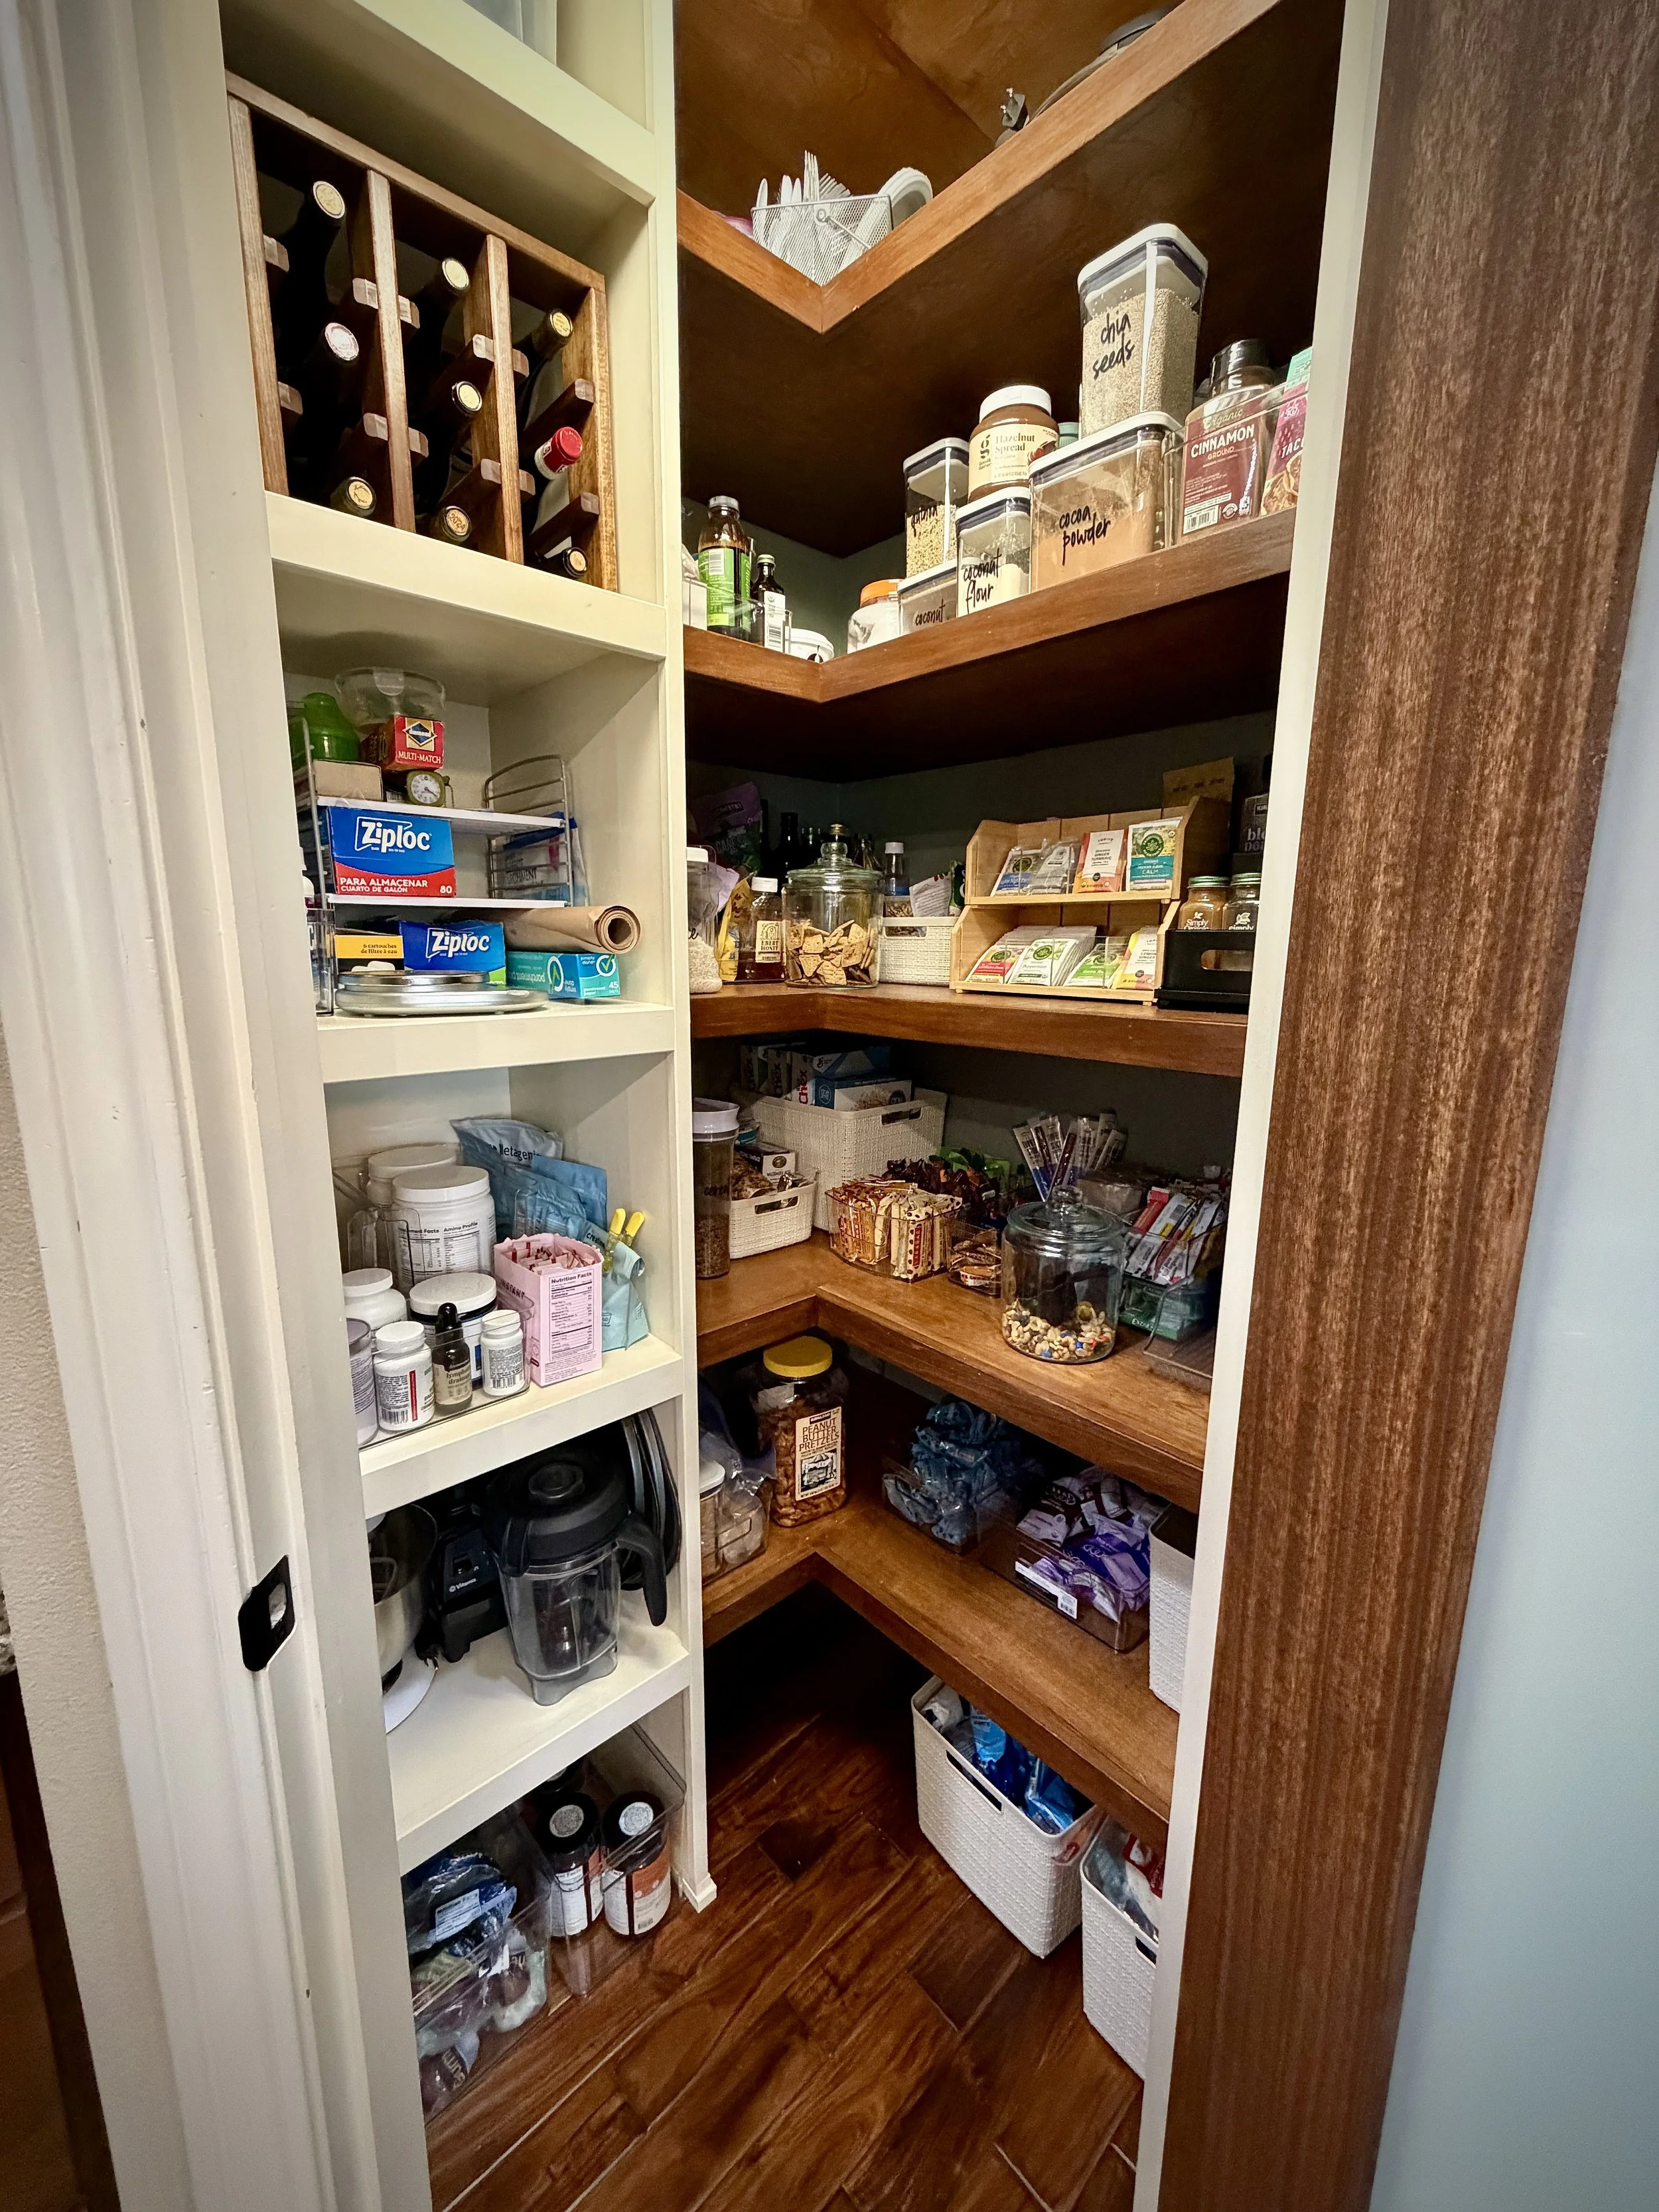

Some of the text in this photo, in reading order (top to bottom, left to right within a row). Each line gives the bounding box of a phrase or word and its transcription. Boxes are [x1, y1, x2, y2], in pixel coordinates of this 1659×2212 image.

[1100, 309, 1131, 344] chia
[1092, 331, 1135, 381] seeds
[1204, 407, 1244, 430] rganic
[995, 433, 1035, 444] Hazelnut
[995, 443, 1025, 455] Spread
[1190, 423, 1255, 458] CINNAMON
[1207, 446, 1235, 461] GROUND
[911, 504, 938, 538] quinoa
[1059, 506, 1092, 530] cocoa
[1062, 511, 1111, 566] powder
[964, 548, 1002, 582] coconut
[966, 579, 994, 615] flour
[915, 599, 946, 626] coconut
[398, 750, 441, 764] MULTI-MATCH
[362, 821, 431, 853] Ziploc
[340, 876, 428, 888] PARA ALMACENAR
[439, 885, 453, 895] 80
[1187, 919, 1209, 927] Simply
[431, 930, 490, 958] Ziploc
[798, 1069, 808, 1104] Chex
[500, 1279, 525, 1299] INSTANT
[551, 1275, 577, 1284] Nutrition
[802, 1417, 837, 1435] PEANUT
[802, 1426, 836, 1443] BUTTER
[799, 1432, 839, 1451] PRETZELS
